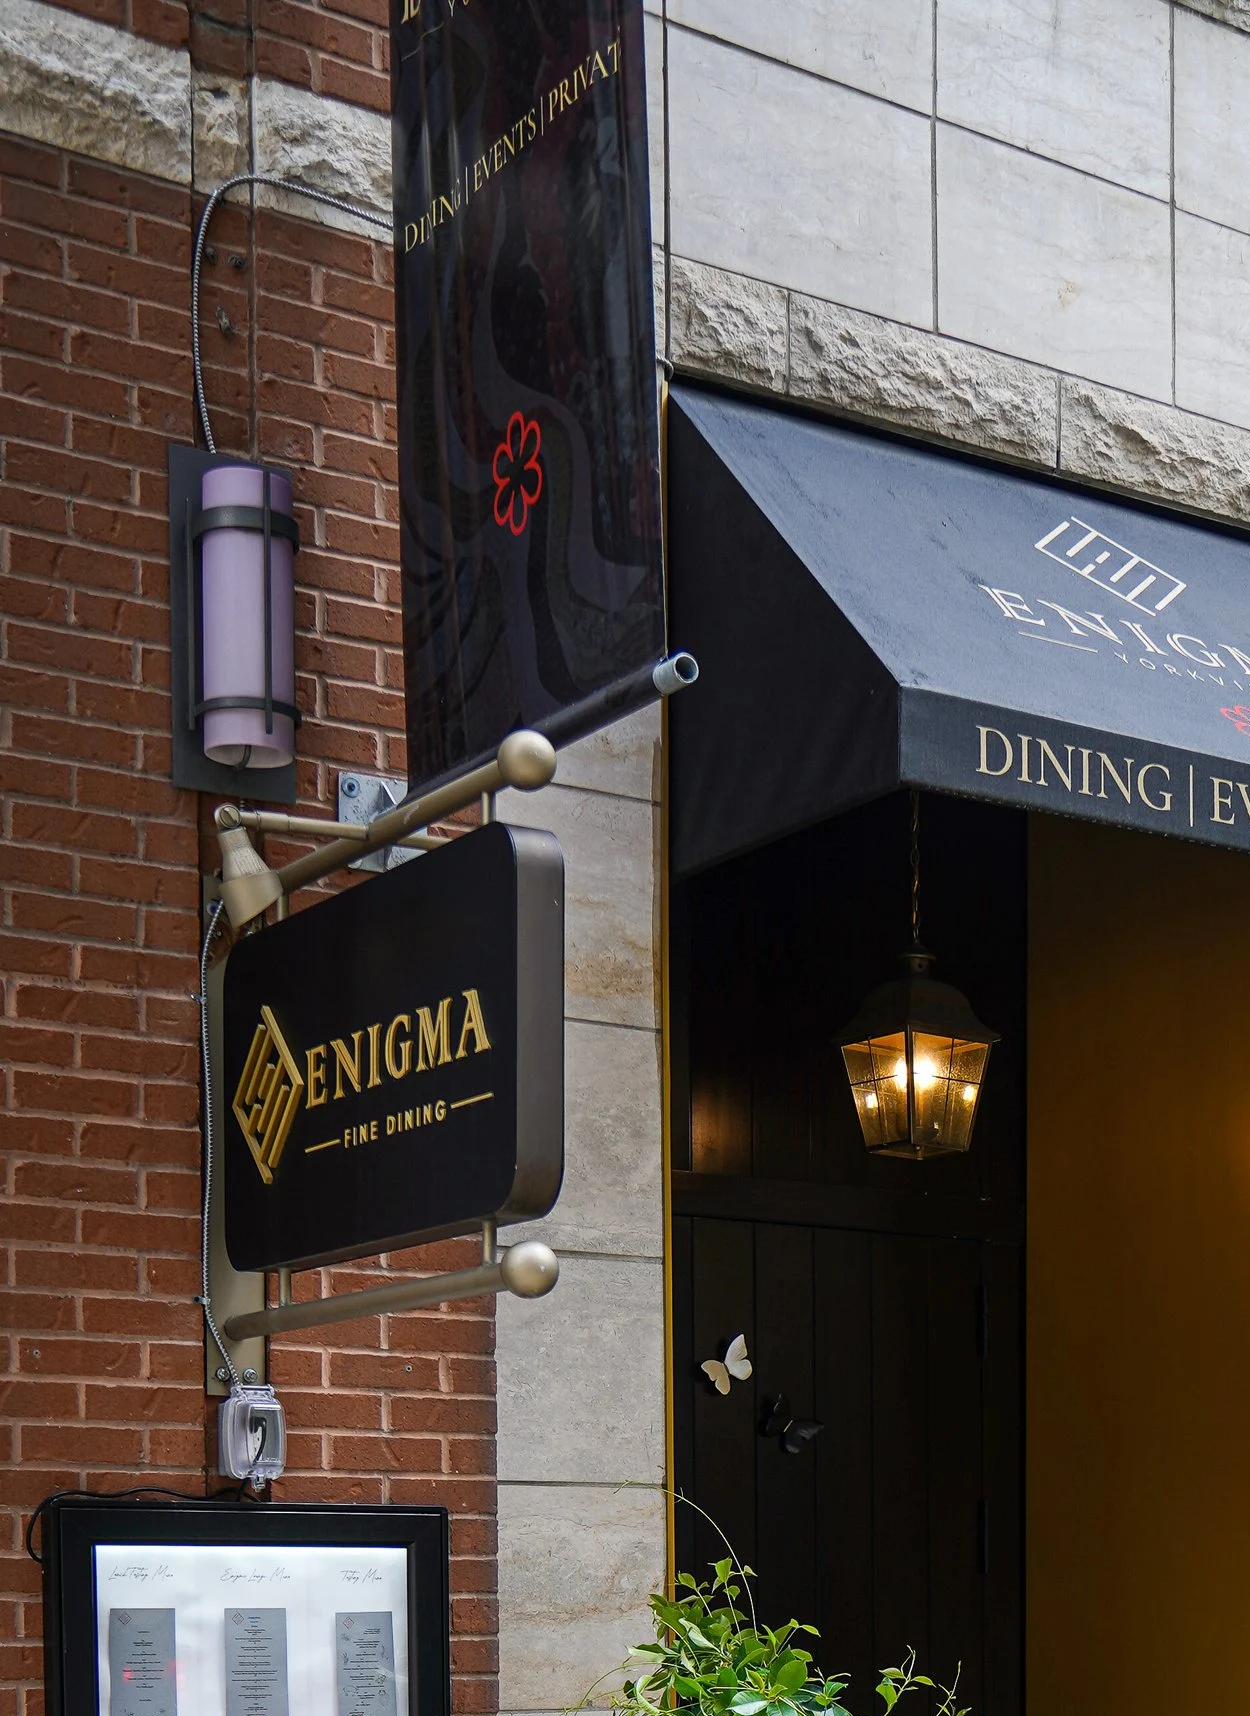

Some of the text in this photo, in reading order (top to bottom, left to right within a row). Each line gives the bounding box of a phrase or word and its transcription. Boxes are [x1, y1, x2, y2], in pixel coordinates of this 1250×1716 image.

[473, 108, 536, 193] EVENTS
[549, 26, 622, 124] PRIVAT
[976, 725, 1174, 812] DINING
[305, 987, 493, 1110] ENIGMA
[344, 1100, 447, 1149] FINE DINING
